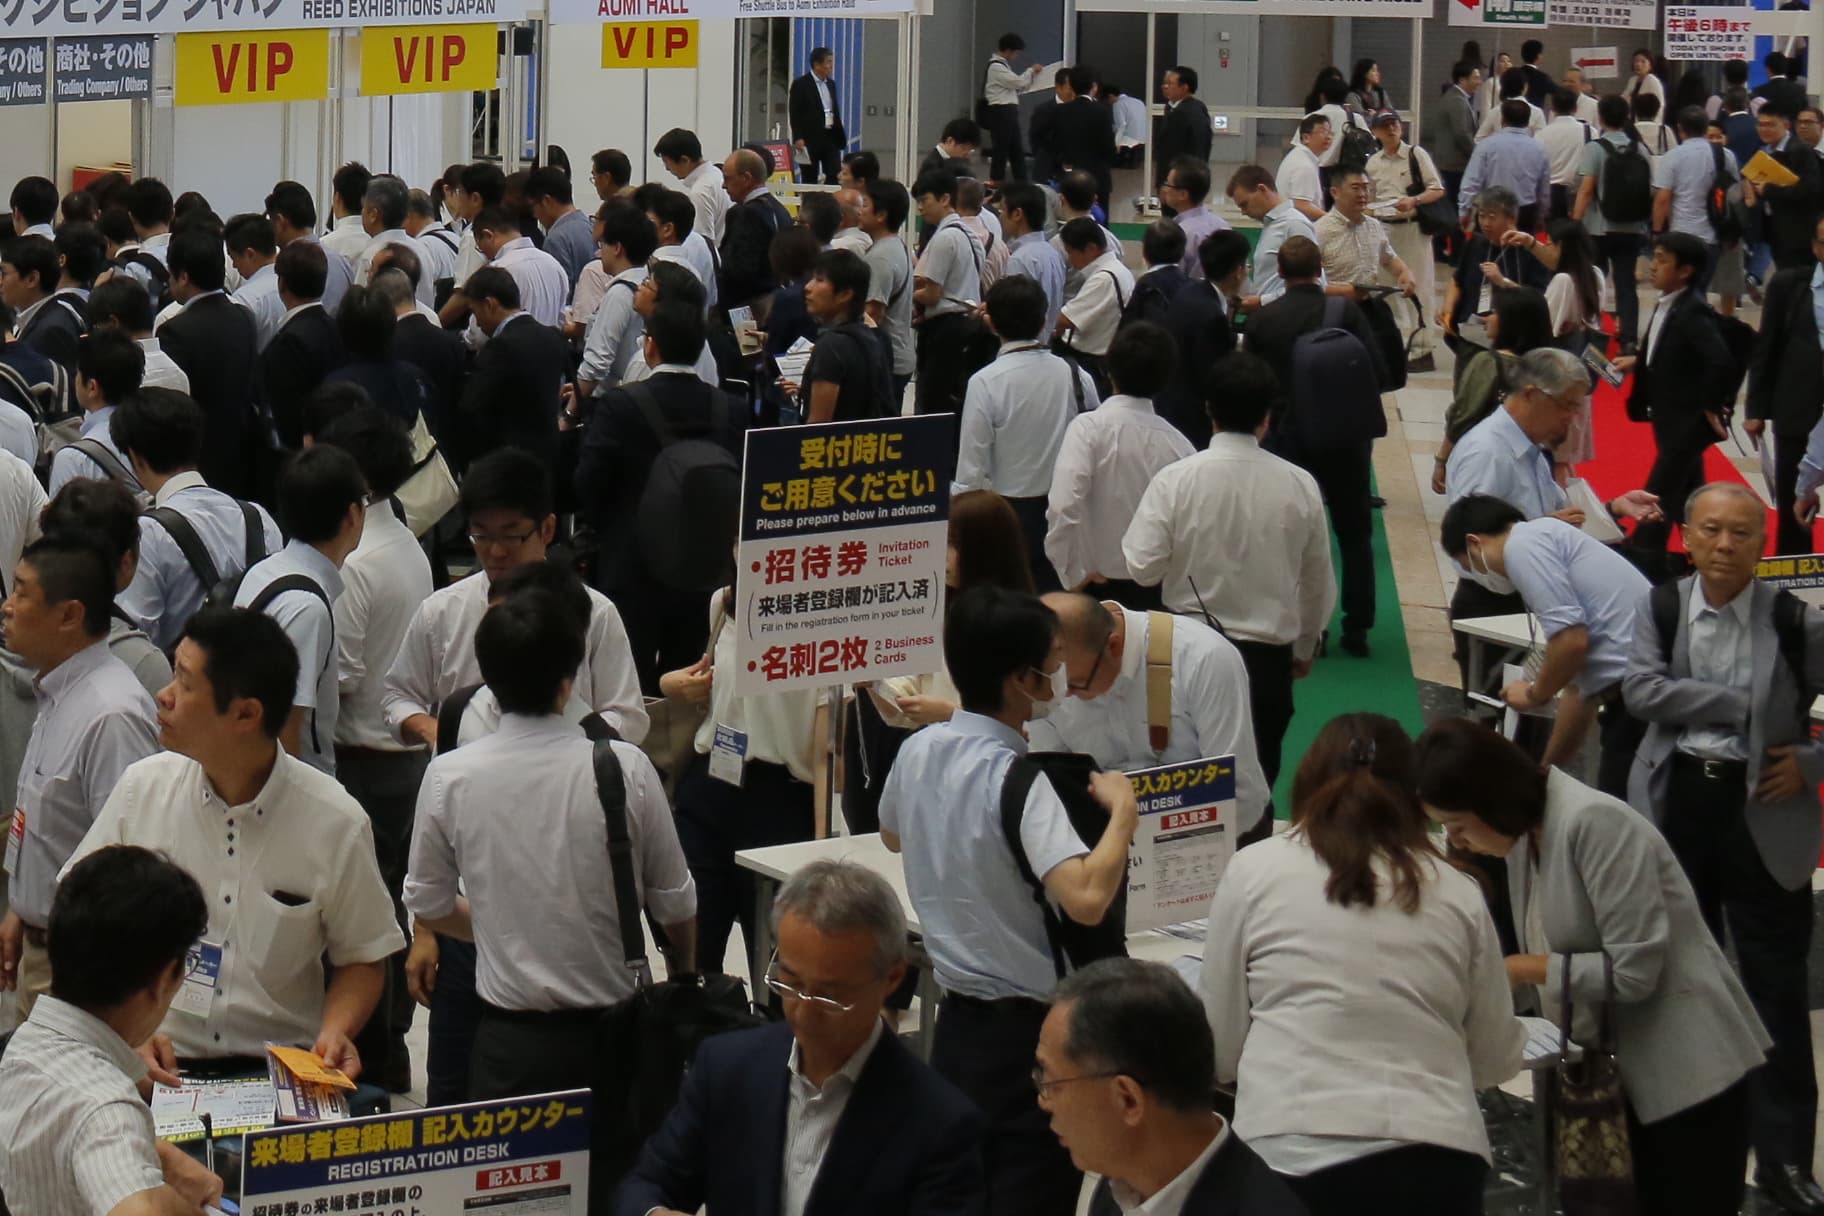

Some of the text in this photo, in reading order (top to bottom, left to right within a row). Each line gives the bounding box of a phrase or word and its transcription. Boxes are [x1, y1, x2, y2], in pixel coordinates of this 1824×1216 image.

[612, 27, 689, 59] VIP
[211, 41, 294, 93] VIP
[393, 35, 466, 83] VIP
[17, 82, 42, 98] Others
[799, 432, 903, 471] 受付時に
[760, 469, 937, 512] ご用意ください
[756, 502, 936, 531] Please prepare below in advance
[878, 539, 929, 555] Invitation
[878, 554, 912, 568] Ticket
[761, 605, 925, 633] Fill the registration form your ticket
[874, 635, 935, 651] 2 Business
[874, 652, 907, 665] Cards
[1151, 795, 1183, 810] DESK
[422, 1104, 584, 1147] 記入カウンター
[328, 1141, 510, 1181] REGISTRATION DESK
[488, 1164, 549, 1188] 記入見本
